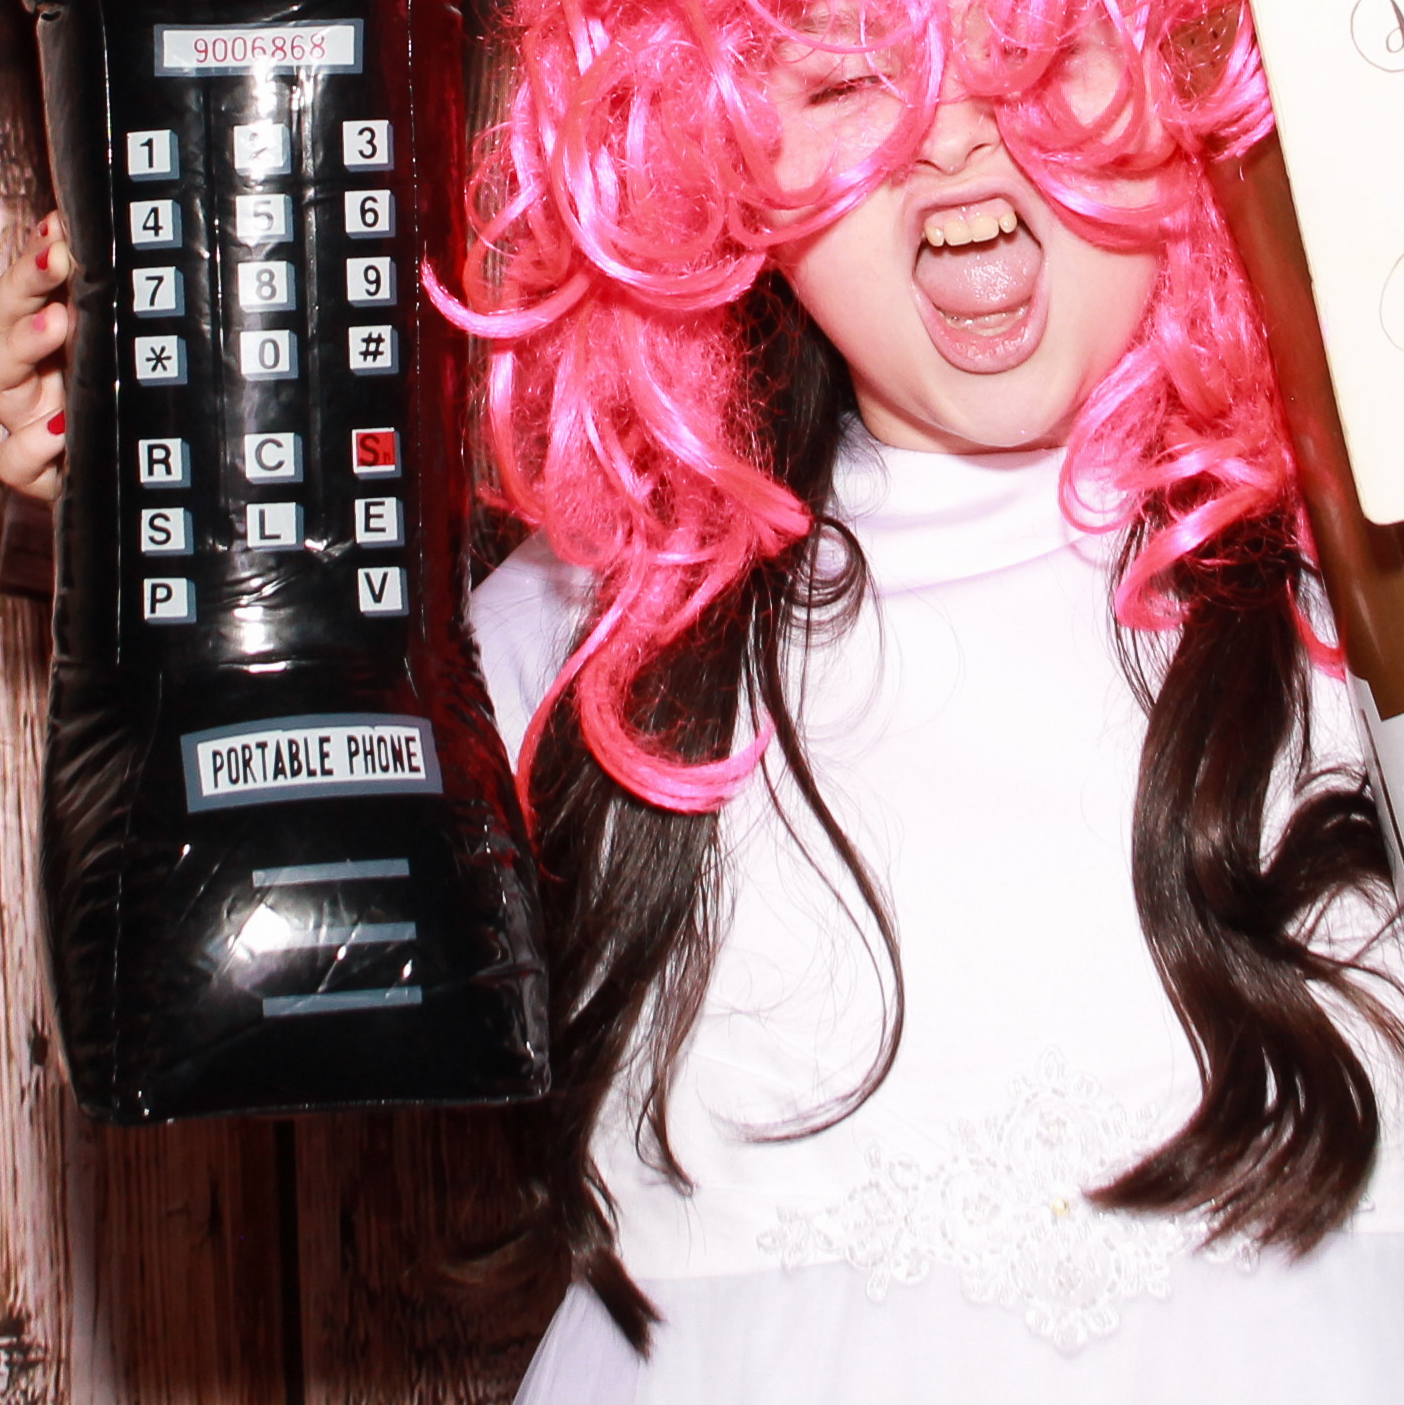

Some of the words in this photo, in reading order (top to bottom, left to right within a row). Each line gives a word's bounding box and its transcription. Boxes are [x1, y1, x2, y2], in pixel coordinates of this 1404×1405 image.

[194, 31, 326, 64] 9006868
[139, 137, 155, 169] 1
[356, 126, 378, 160] 3
[142, 206, 164, 238] 4
[251, 200, 275, 232] 5
[359, 196, 380, 228] 6
[144, 275, 165, 307] 7
[255, 268, 277, 301] 8
[362, 264, 382, 296] 9
[358, 331, 386, 363] #
[147, 443, 173, 477] R
[254, 437, 285, 472] C
[147, 512, 172, 545] S
[258, 508, 282, 541] L
[363, 500, 387, 534] E
[149, 582, 173, 615] P
[363, 571, 389, 605] V
[211, 735, 334, 789] PORTABLE
[346, 733, 421, 776] PHONE
